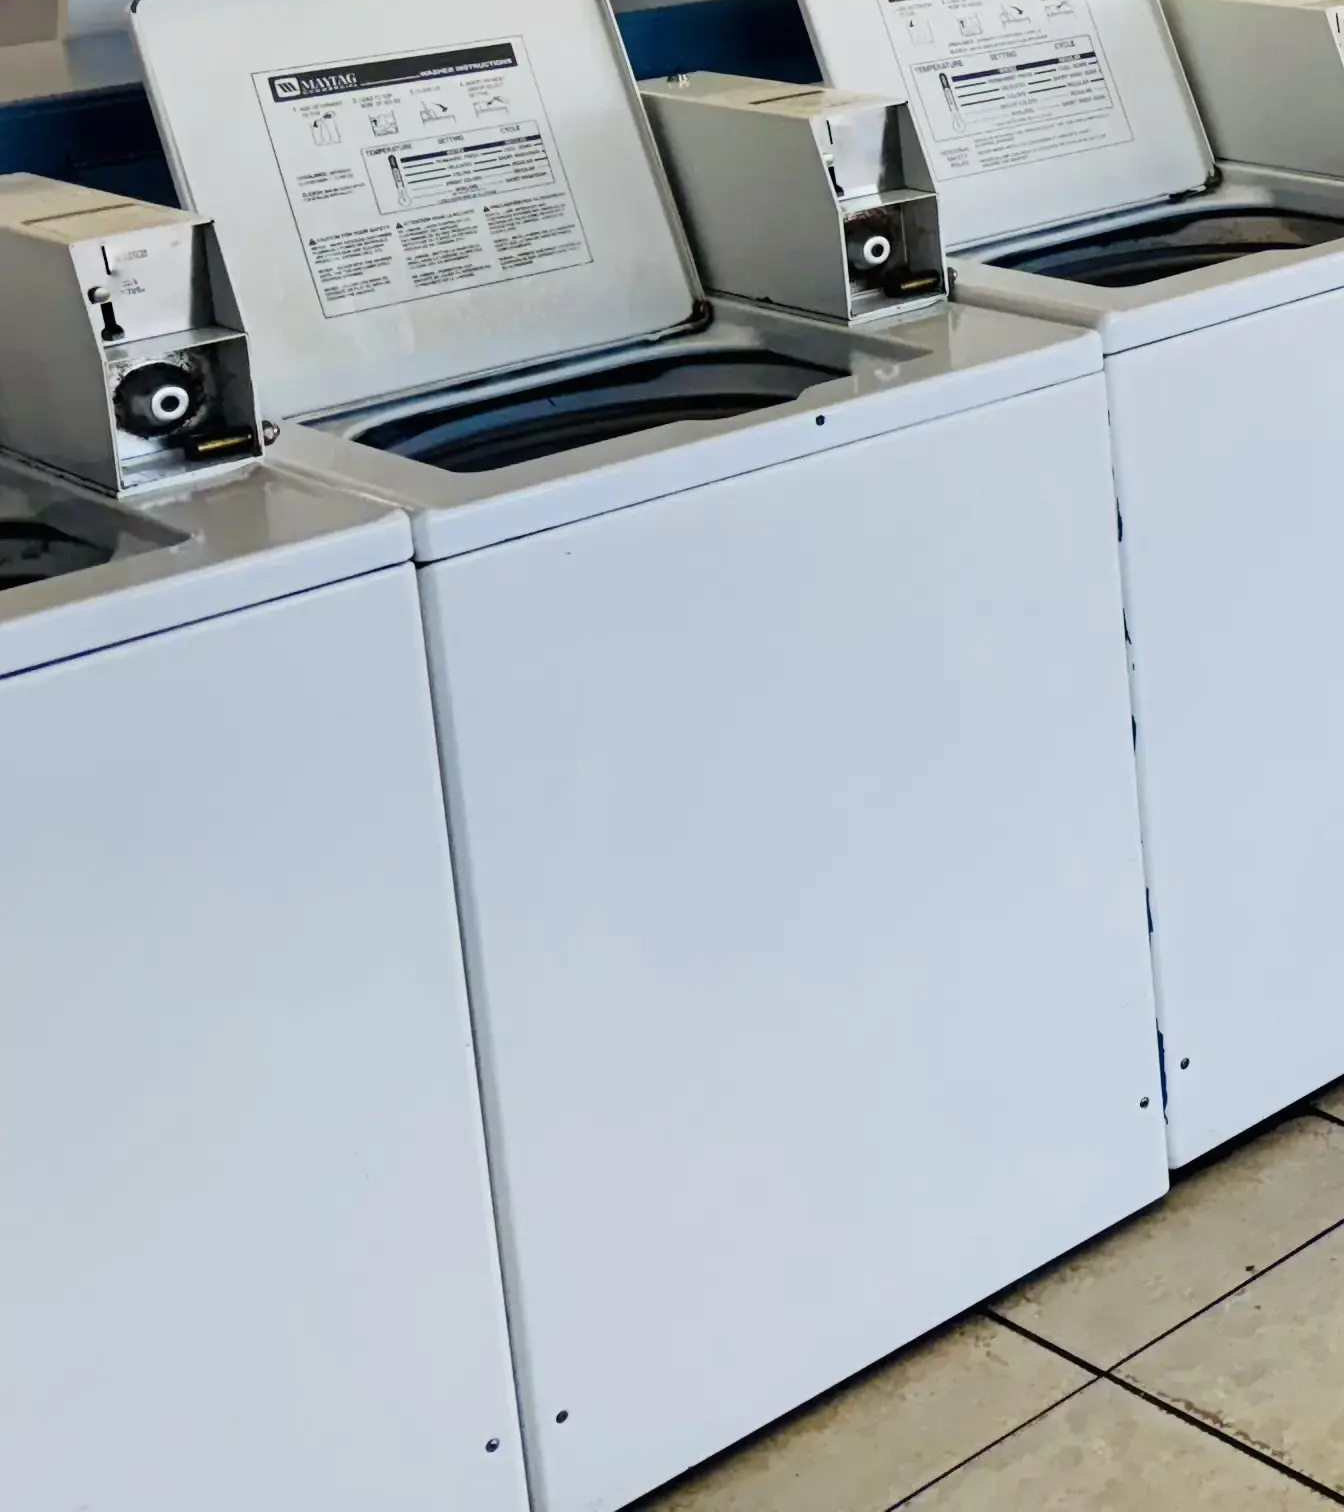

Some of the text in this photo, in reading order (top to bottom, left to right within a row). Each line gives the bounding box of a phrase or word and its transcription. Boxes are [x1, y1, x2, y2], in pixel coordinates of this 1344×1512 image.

[1054, 40, 1076, 51] CYCLE
[455, 58, 513, 73] INSTRUCTIONS
[914, 59, 965, 73] TEMPERATURE
[299, 72, 357, 90] MAYTAG
